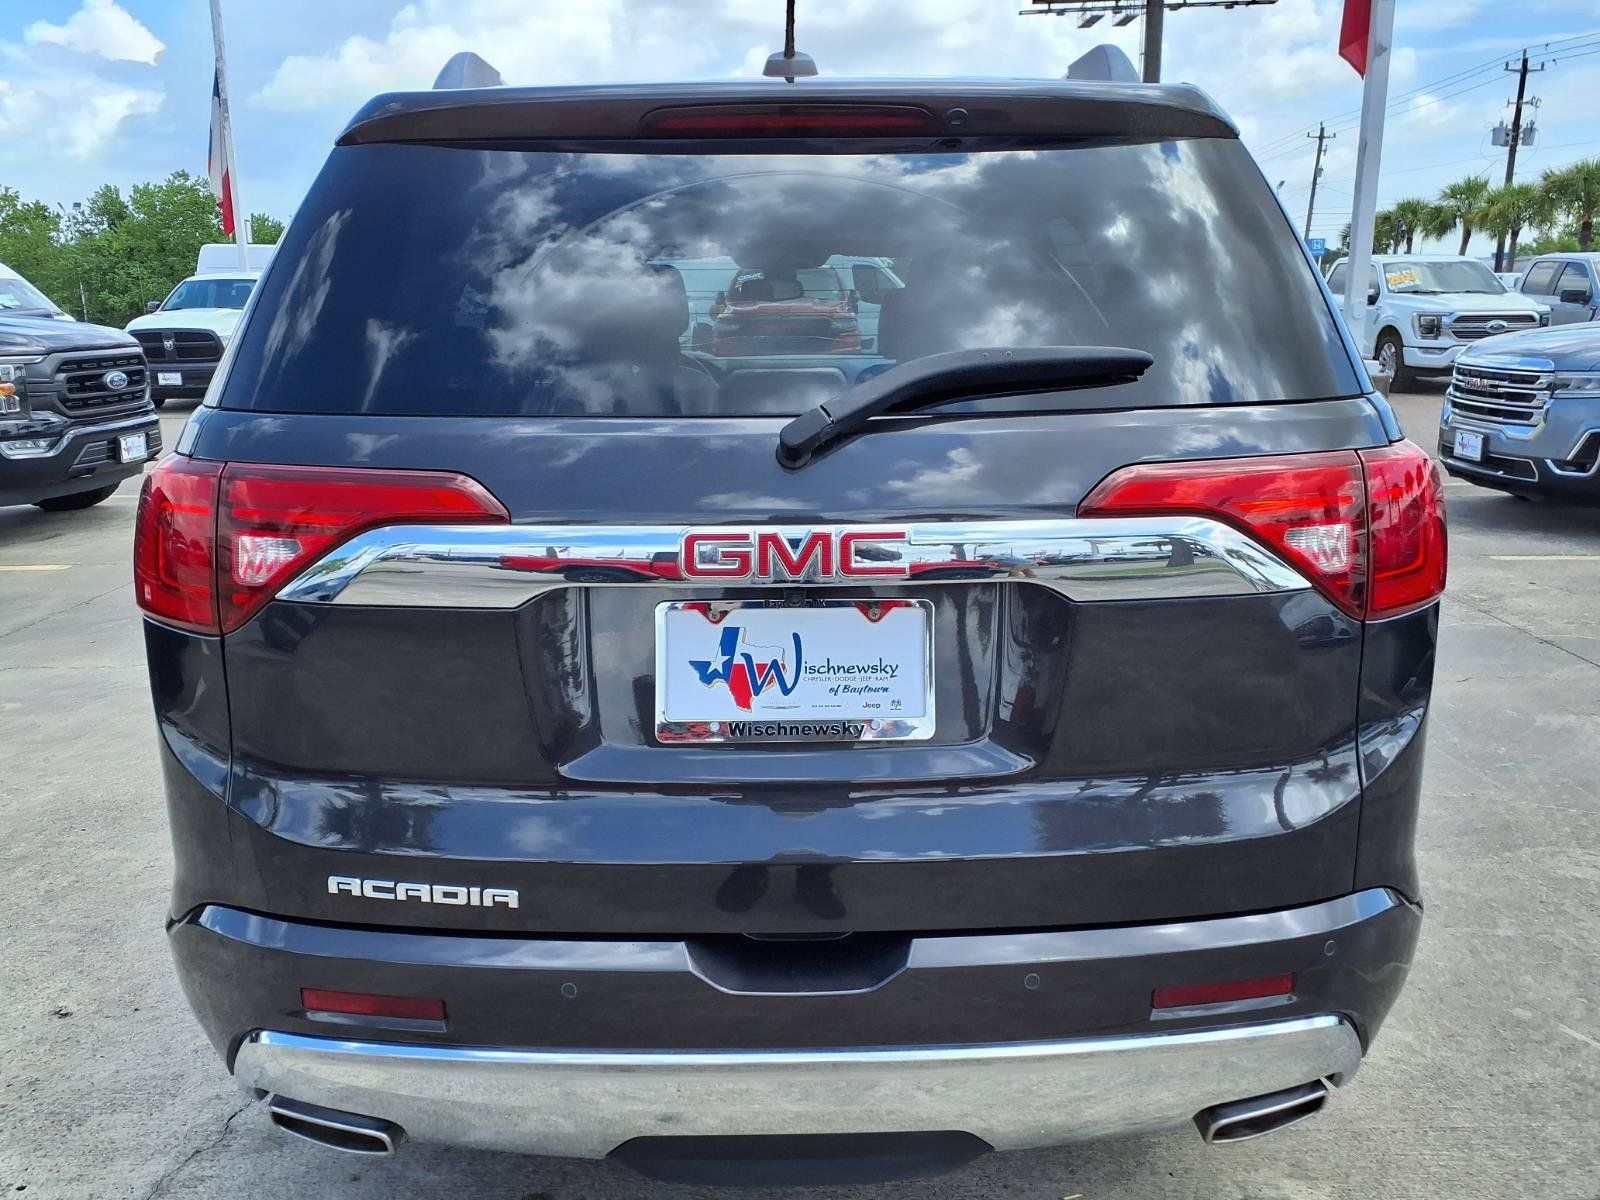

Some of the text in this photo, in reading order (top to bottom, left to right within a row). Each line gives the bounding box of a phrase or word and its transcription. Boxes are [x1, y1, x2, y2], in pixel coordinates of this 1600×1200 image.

[682, 529, 909, 578] GMC
[829, 684, 889, 696] of Baytown
[862, 701, 881, 709] Jeep
[728, 720, 865, 738] Wischnewsky
[328, 876, 519, 909] ACADIA
